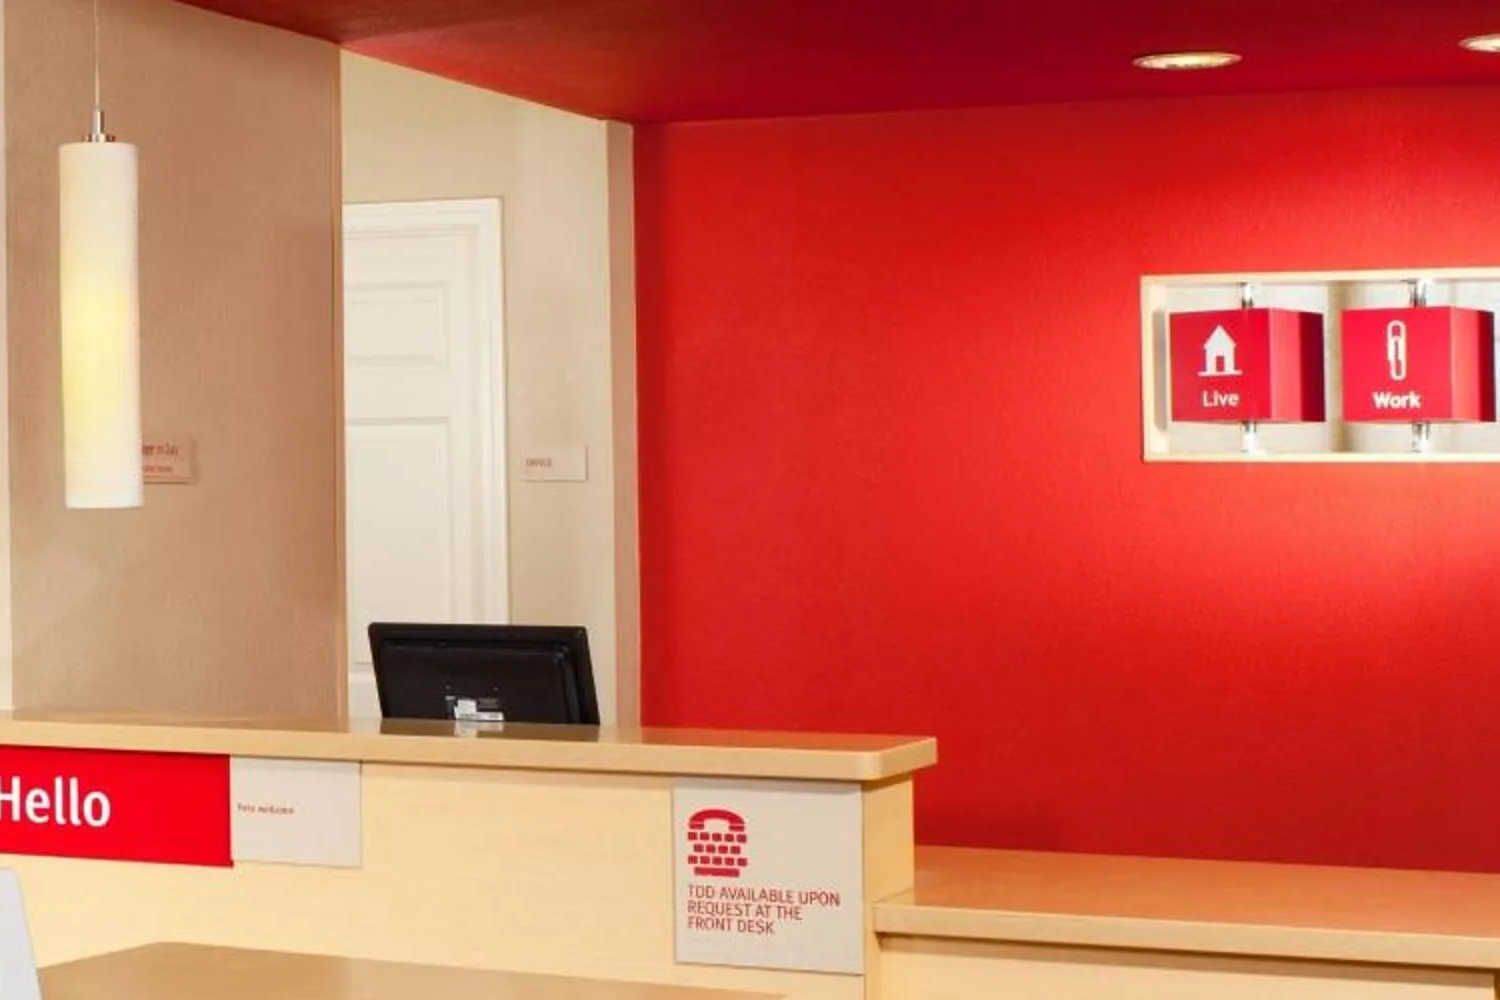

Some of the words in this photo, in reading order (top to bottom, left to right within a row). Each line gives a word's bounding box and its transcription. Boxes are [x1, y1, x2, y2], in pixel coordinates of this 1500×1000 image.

[1202, 390, 1240, 407] Live
[1372, 391, 1421, 409] Work
[687, 884, 715, 899] TDD
[719, 887, 793, 904] AVAILABLE
[798, 890, 841, 907] UPON
[688, 900, 750, 918] REQUEST
[755, 904, 771, 917] AT
[776, 906, 802, 920] THE
[688, 916, 732, 932] FRONT
[738, 919, 775, 934] DESK
